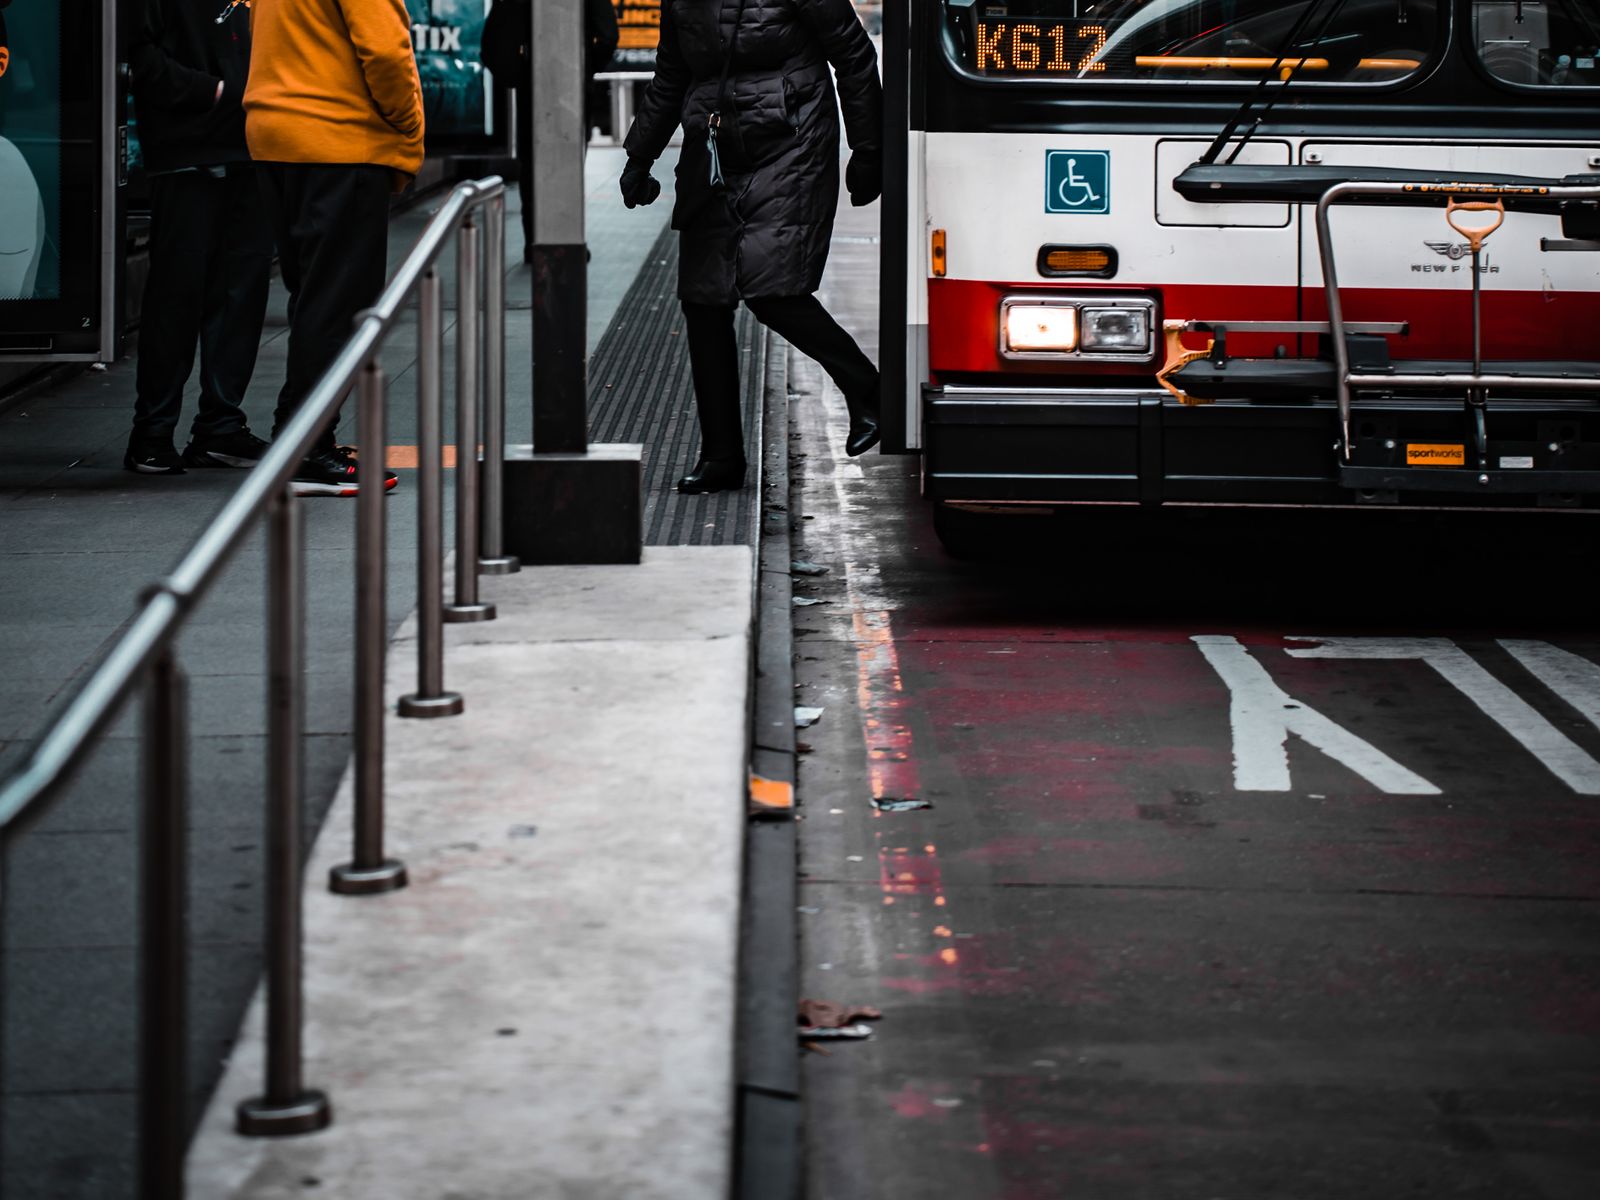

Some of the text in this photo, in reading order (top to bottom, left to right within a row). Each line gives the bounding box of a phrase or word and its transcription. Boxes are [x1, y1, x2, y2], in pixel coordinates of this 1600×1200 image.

[977, 22, 1107, 71] K612
[1410, 264, 1500, 274] NEW FER
[1408, 449, 1463, 459] sportworks
